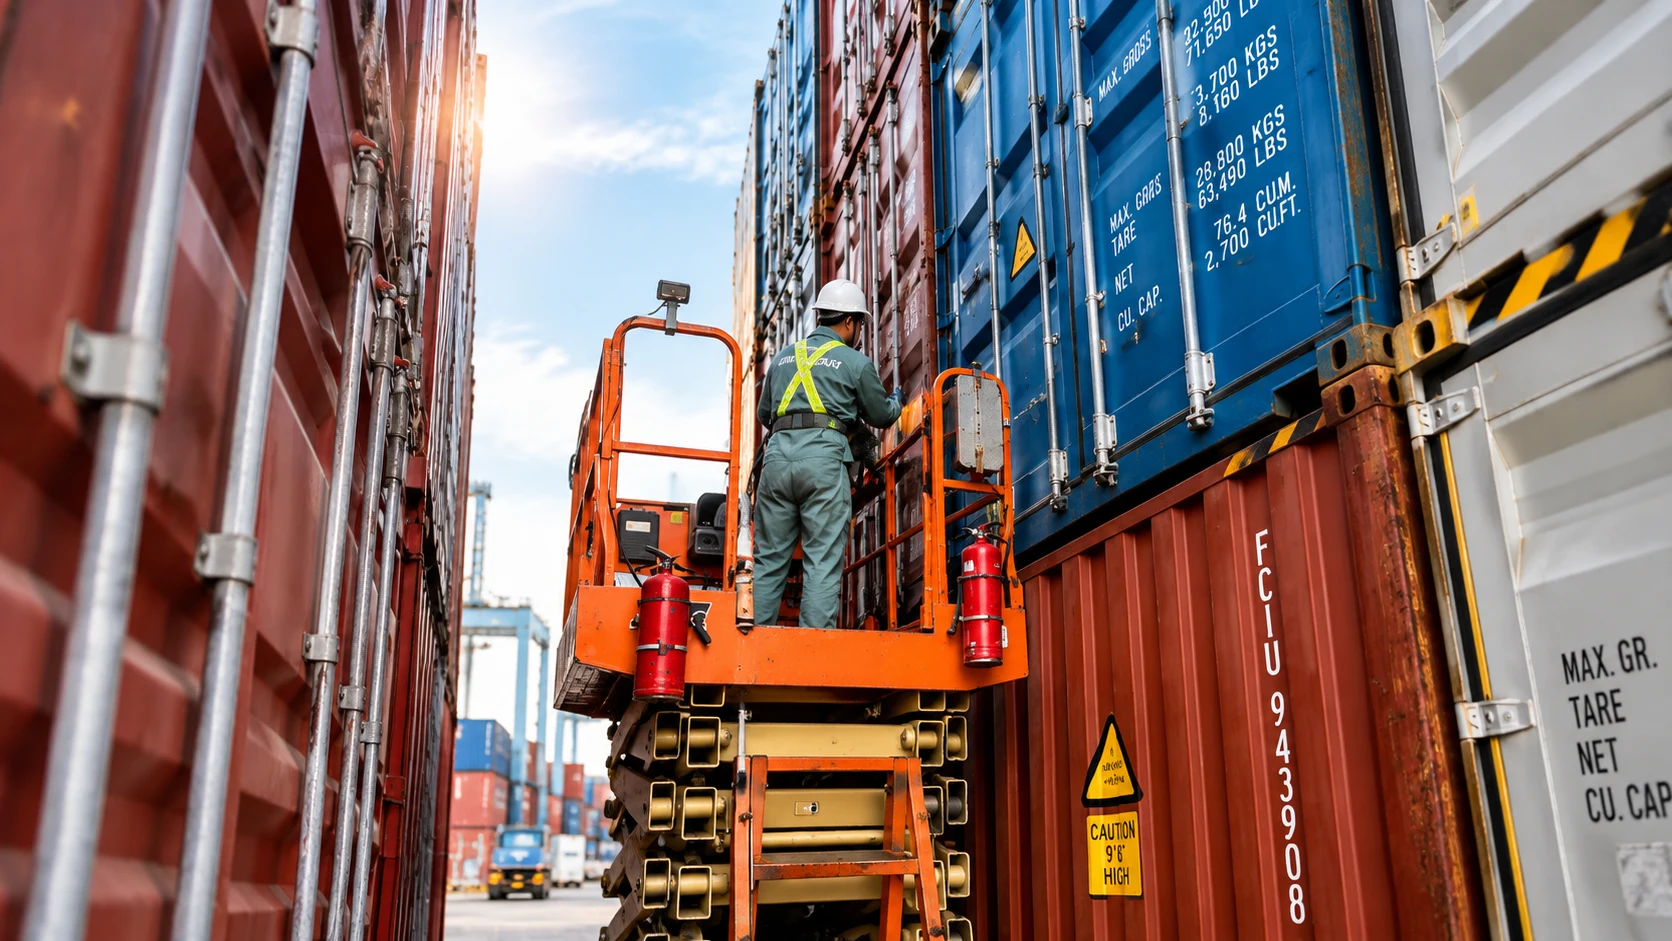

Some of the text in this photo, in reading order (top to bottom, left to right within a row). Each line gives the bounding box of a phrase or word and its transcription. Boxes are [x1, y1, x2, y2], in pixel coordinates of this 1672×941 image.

[1244, 24, 1277, 66] KGS
[1098, 66, 1122, 103] MAX.
[1247, 48, 1279, 89] LBS
[1251, 103, 1285, 144] KGS
[1198, 127, 1287, 210] 63,490 LBS
[1109, 201, 1133, 234] MAX.
[1213, 202, 1247, 240] 76.4
[1111, 219, 1137, 257] TARE
[1204, 226, 1249, 272] 2,700
[1114, 262, 1134, 295] NET
[1117, 284, 1163, 332] CU. CAP.
[1560, 635, 1658, 685] MAX. GR.
[1254, 528, 1306, 924] FCIU 943908
[1567, 688, 1626, 729] TARE
[1576, 737, 1618, 775] NET
[1584, 786, 1624, 824] CU.
[1090, 819, 1136, 841] CAUTION
[1103, 866, 1130, 885] HIGH
